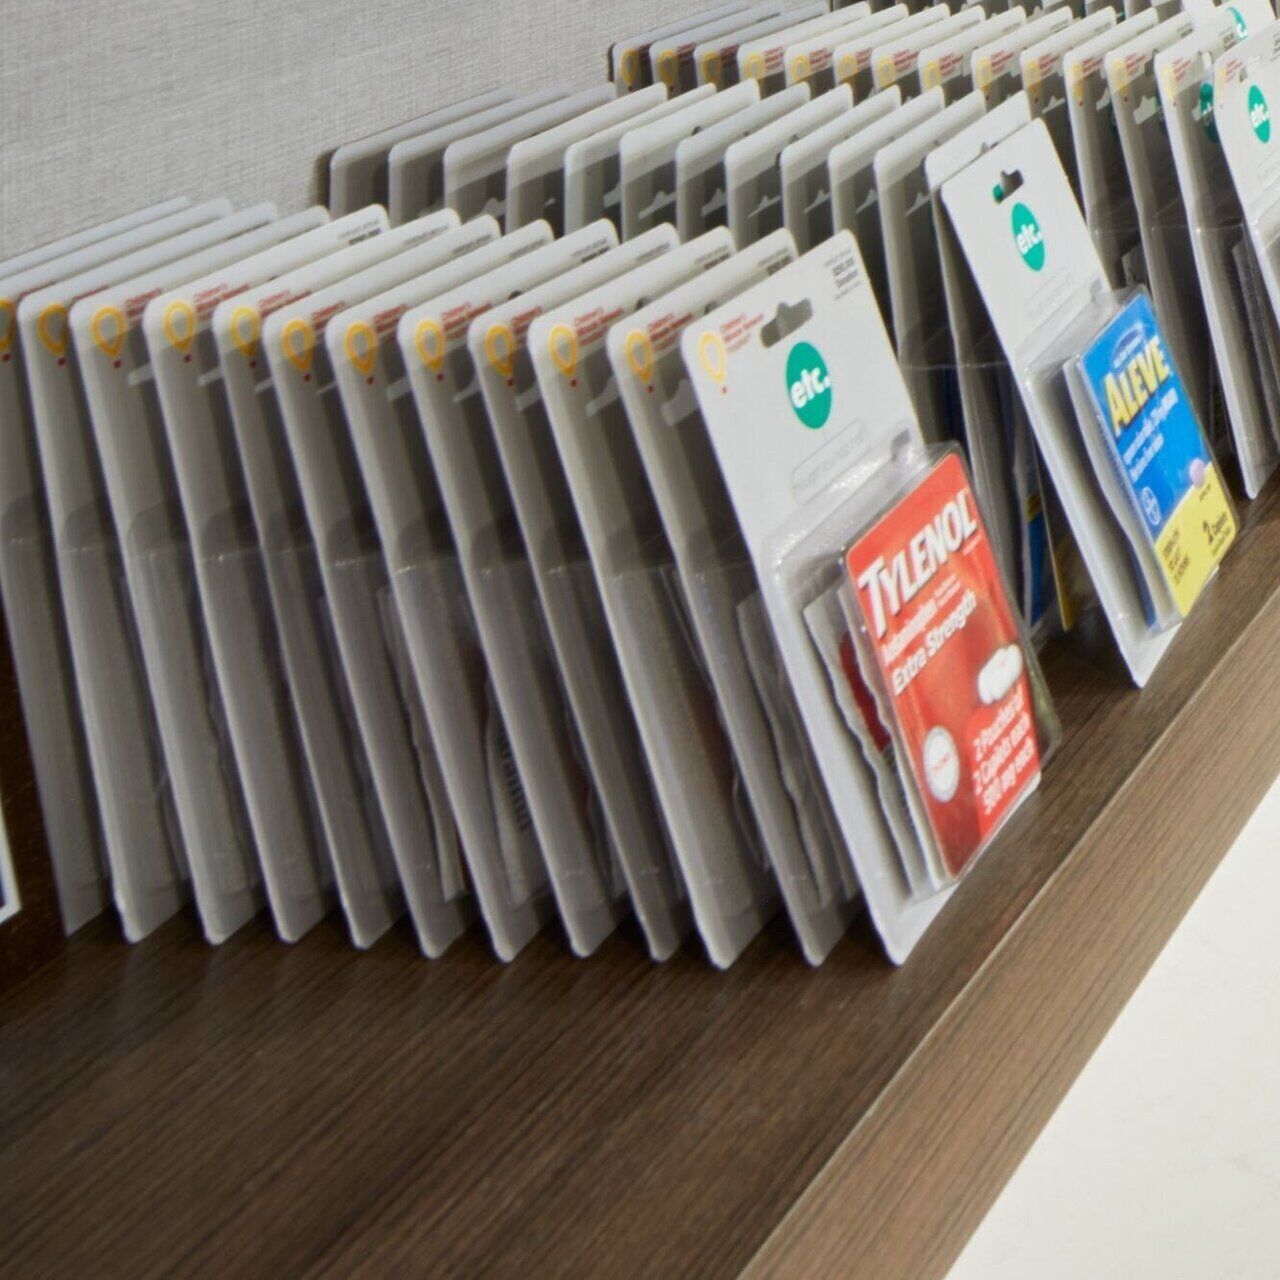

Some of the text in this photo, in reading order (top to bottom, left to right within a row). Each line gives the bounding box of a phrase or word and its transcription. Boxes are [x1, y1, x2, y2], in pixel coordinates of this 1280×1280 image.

[1015, 222, 1044, 258] etc.
[788, 367, 831, 409] etc.
[1104, 334, 1172, 439] ALEVE
[857, 489, 979, 641] TYLENOL
[1202, 519, 1215, 545] 2
[892, 587, 977, 698] Extra Strength
